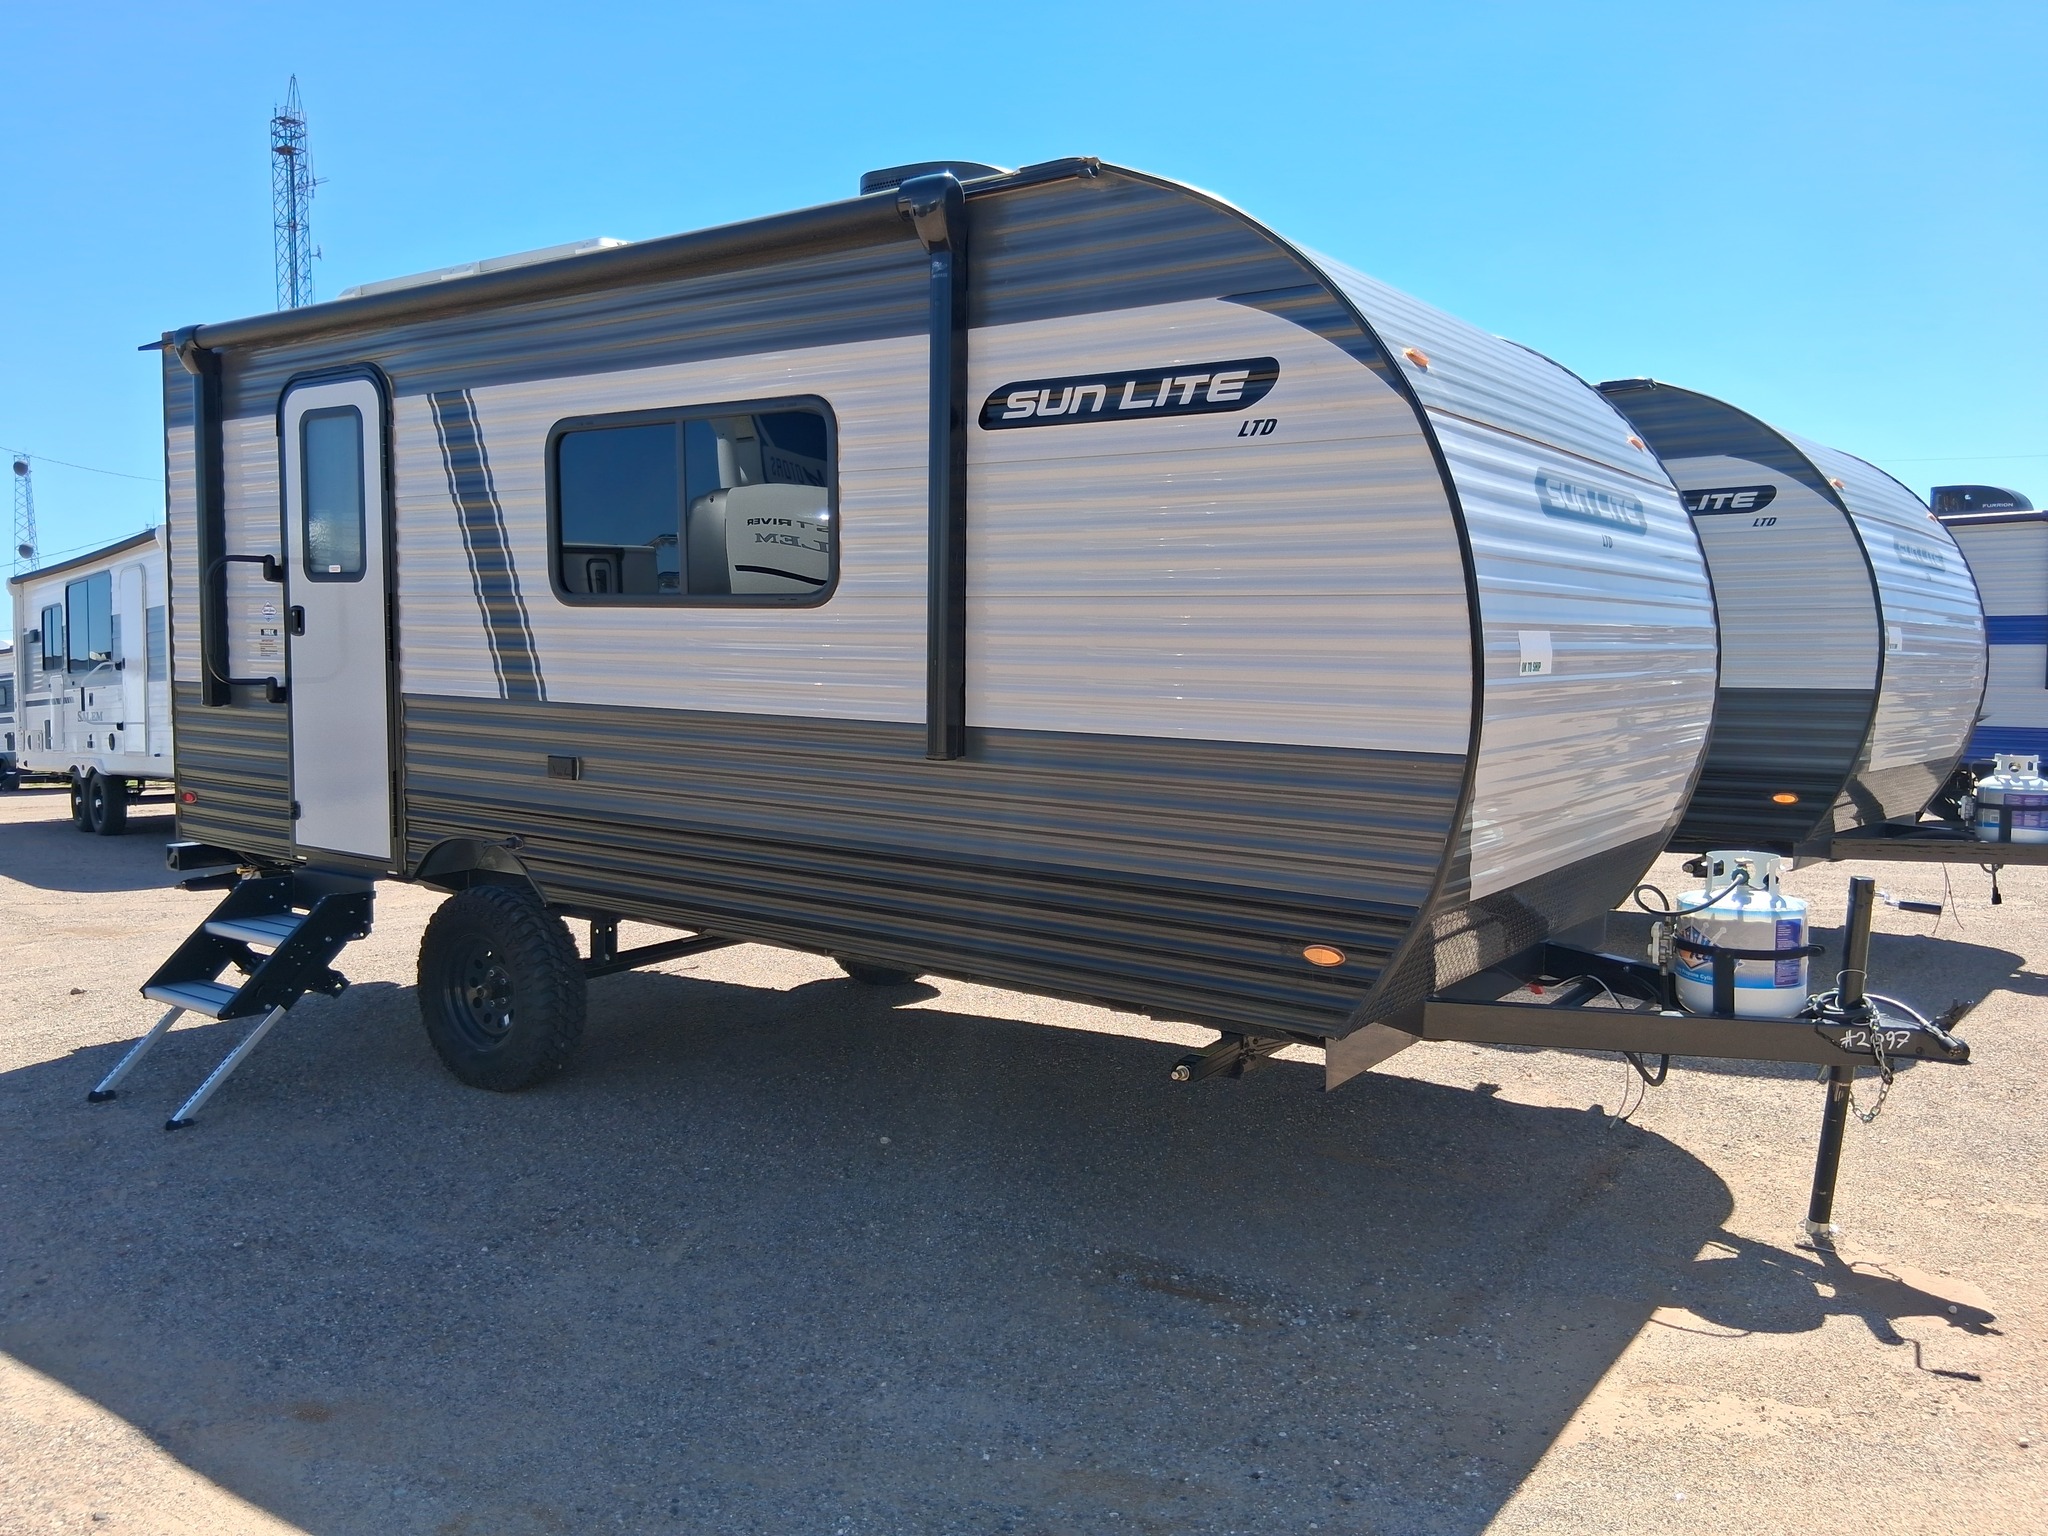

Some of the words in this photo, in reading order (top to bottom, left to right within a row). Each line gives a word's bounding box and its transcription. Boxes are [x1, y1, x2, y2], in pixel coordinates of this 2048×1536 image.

[1002, 384, 1106, 419] SUN
[1119, 370, 1249, 411] LITE
[1237, 418, 1277, 437] LTD
[1546, 479, 1594, 514] SUN
[1594, 491, 1641, 525] LITE
[1752, 517, 1777, 527] LTD
[1602, 534, 1613, 549] LTD
[77, 710, 103, 722] SALEM
